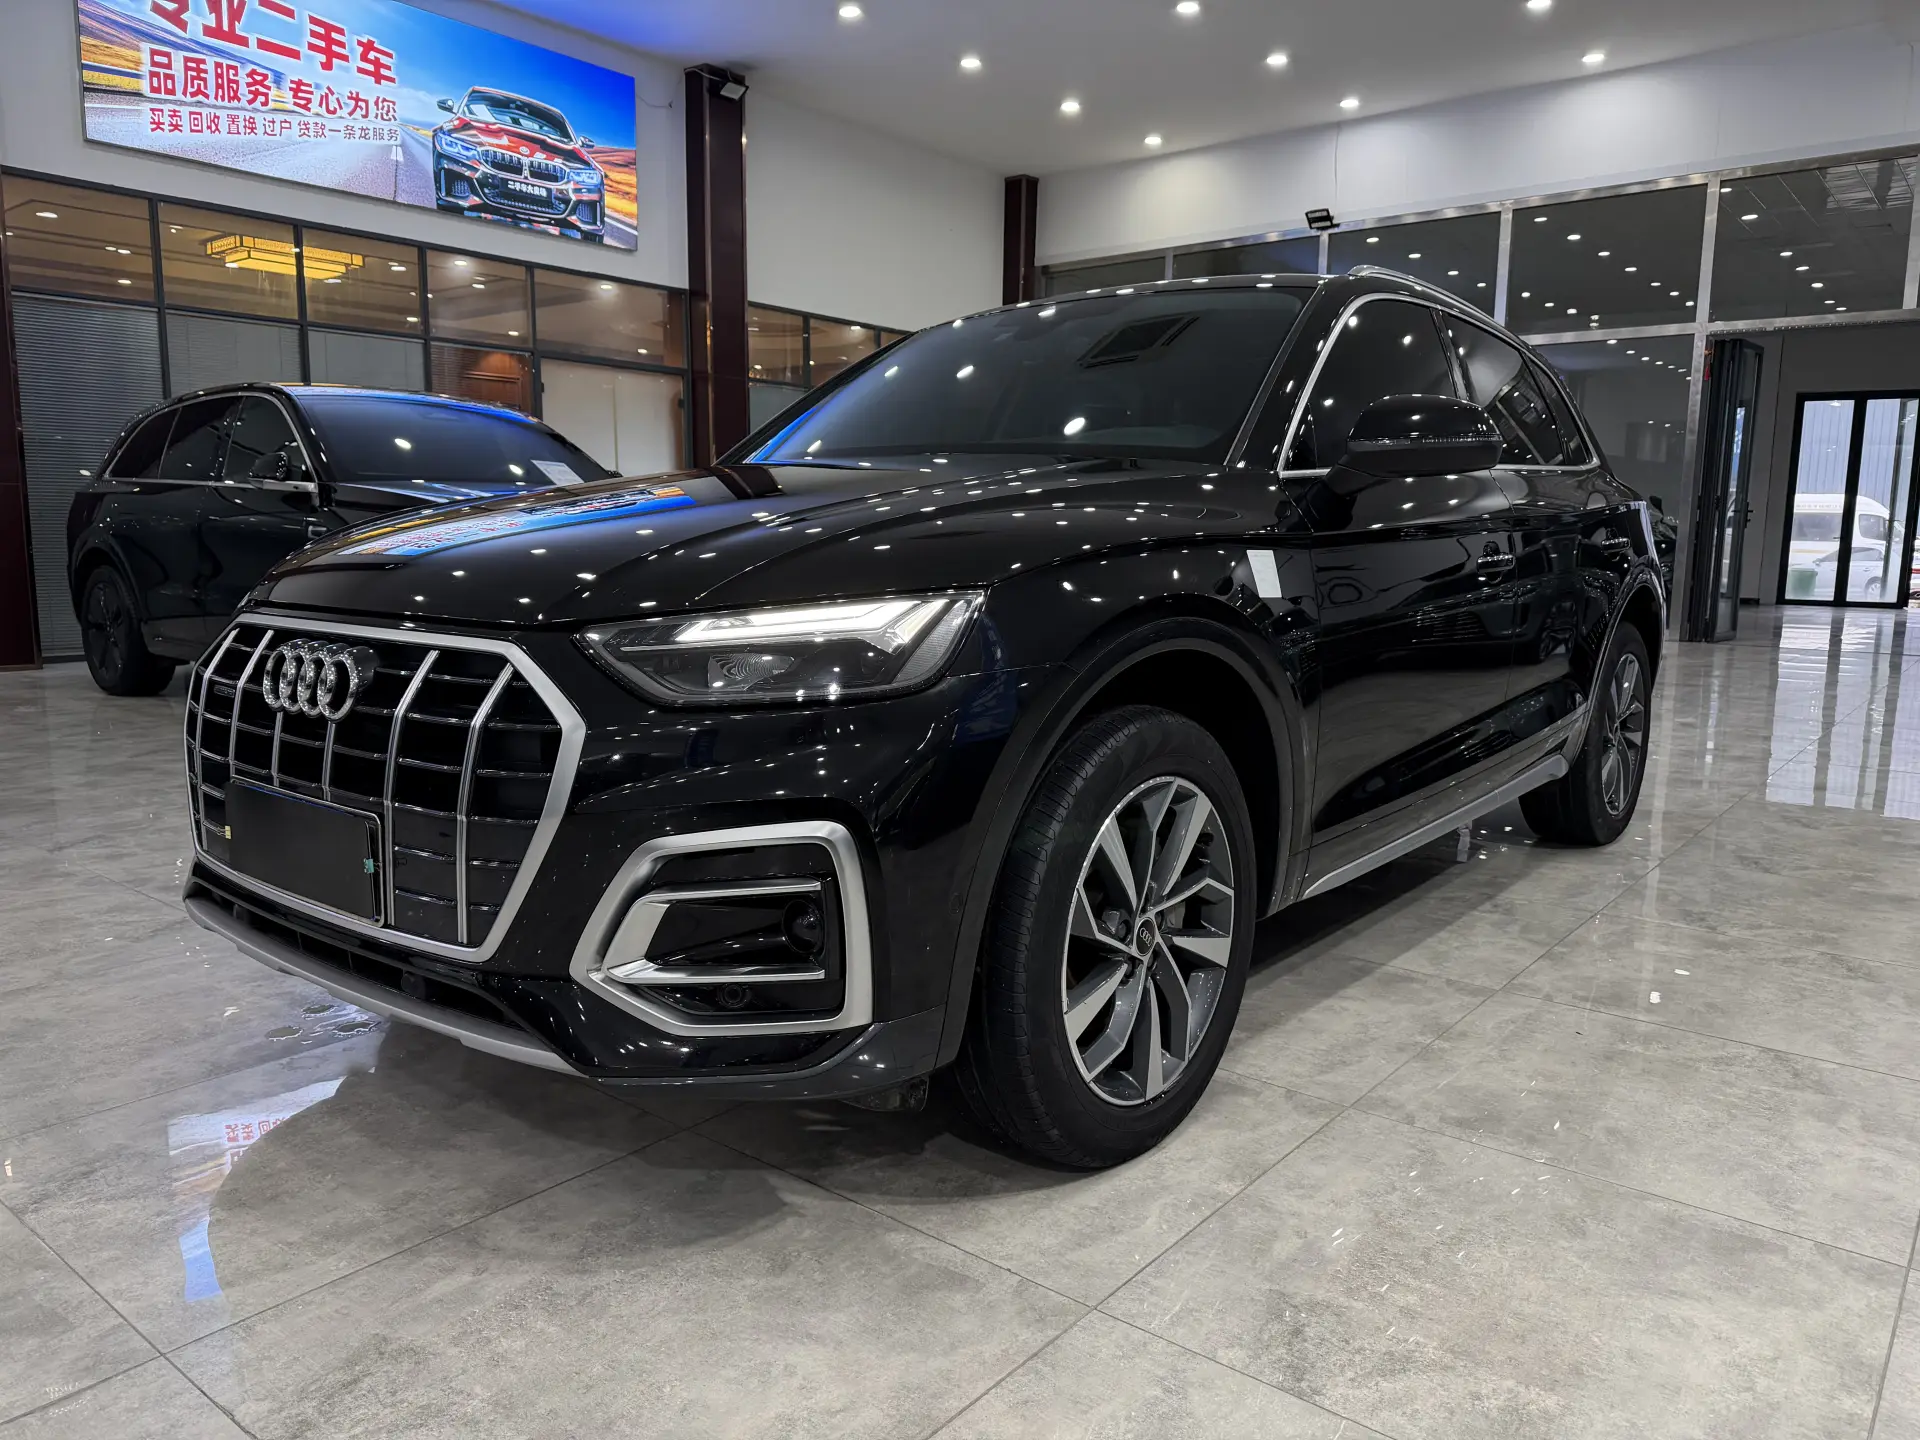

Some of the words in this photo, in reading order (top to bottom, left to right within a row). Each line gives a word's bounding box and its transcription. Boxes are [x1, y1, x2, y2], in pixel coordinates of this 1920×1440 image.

[148, 46, 272, 108] 品质服务
[288, 77, 399, 123] 专心为您
[149, 107, 184, 134] 买卖
[188, 107, 222, 136] 回收
[226, 113, 258, 137] 置换
[262, 117, 293, 138] 过户
[297, 120, 400, 142] 贷款一条龙服务
